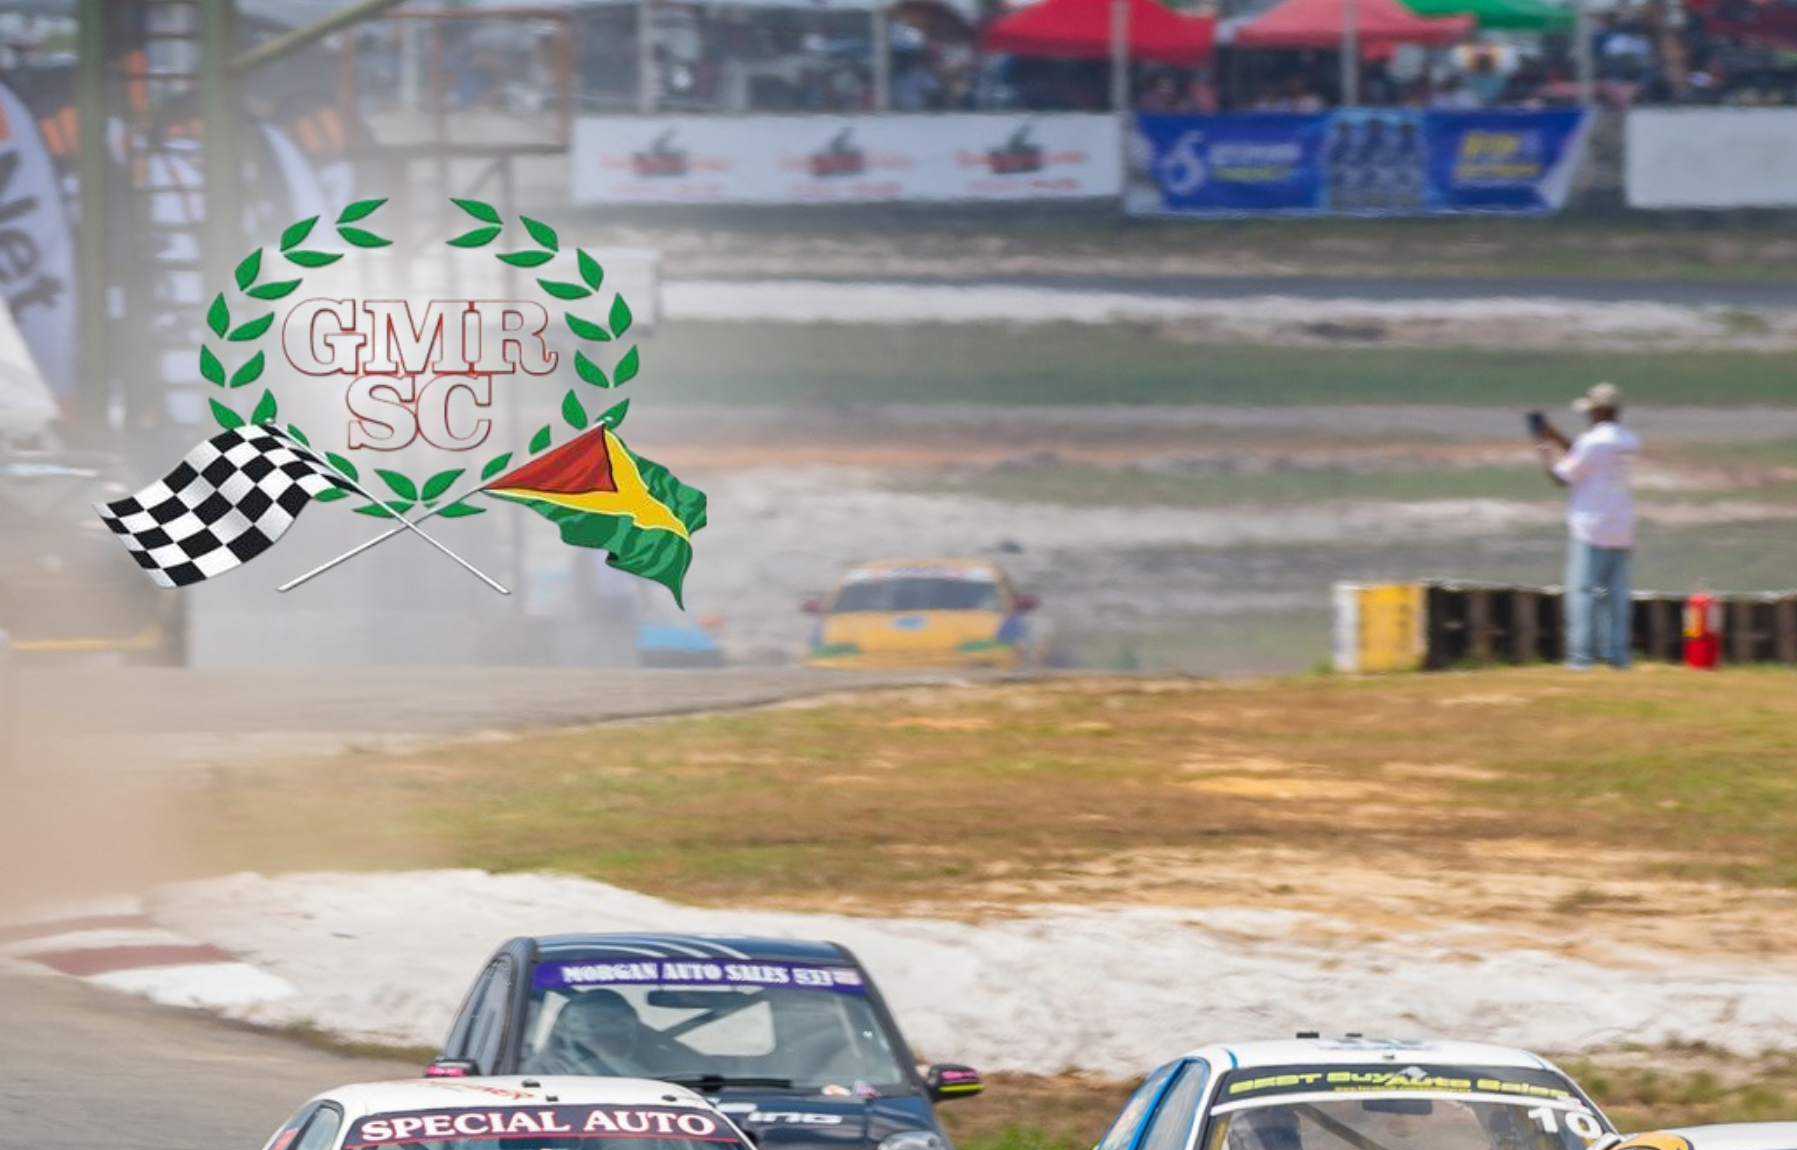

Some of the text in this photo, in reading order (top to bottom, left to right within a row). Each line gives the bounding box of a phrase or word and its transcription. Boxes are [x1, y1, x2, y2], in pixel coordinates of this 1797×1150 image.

[561, 962, 659, 984] MORGAN
[661, 963, 723, 981] AUTO
[724, 964, 789, 984] SALES
[361, 1110, 716, 1141] SPECIAL AUTO
[1528, 1106, 1602, 1140] 10
